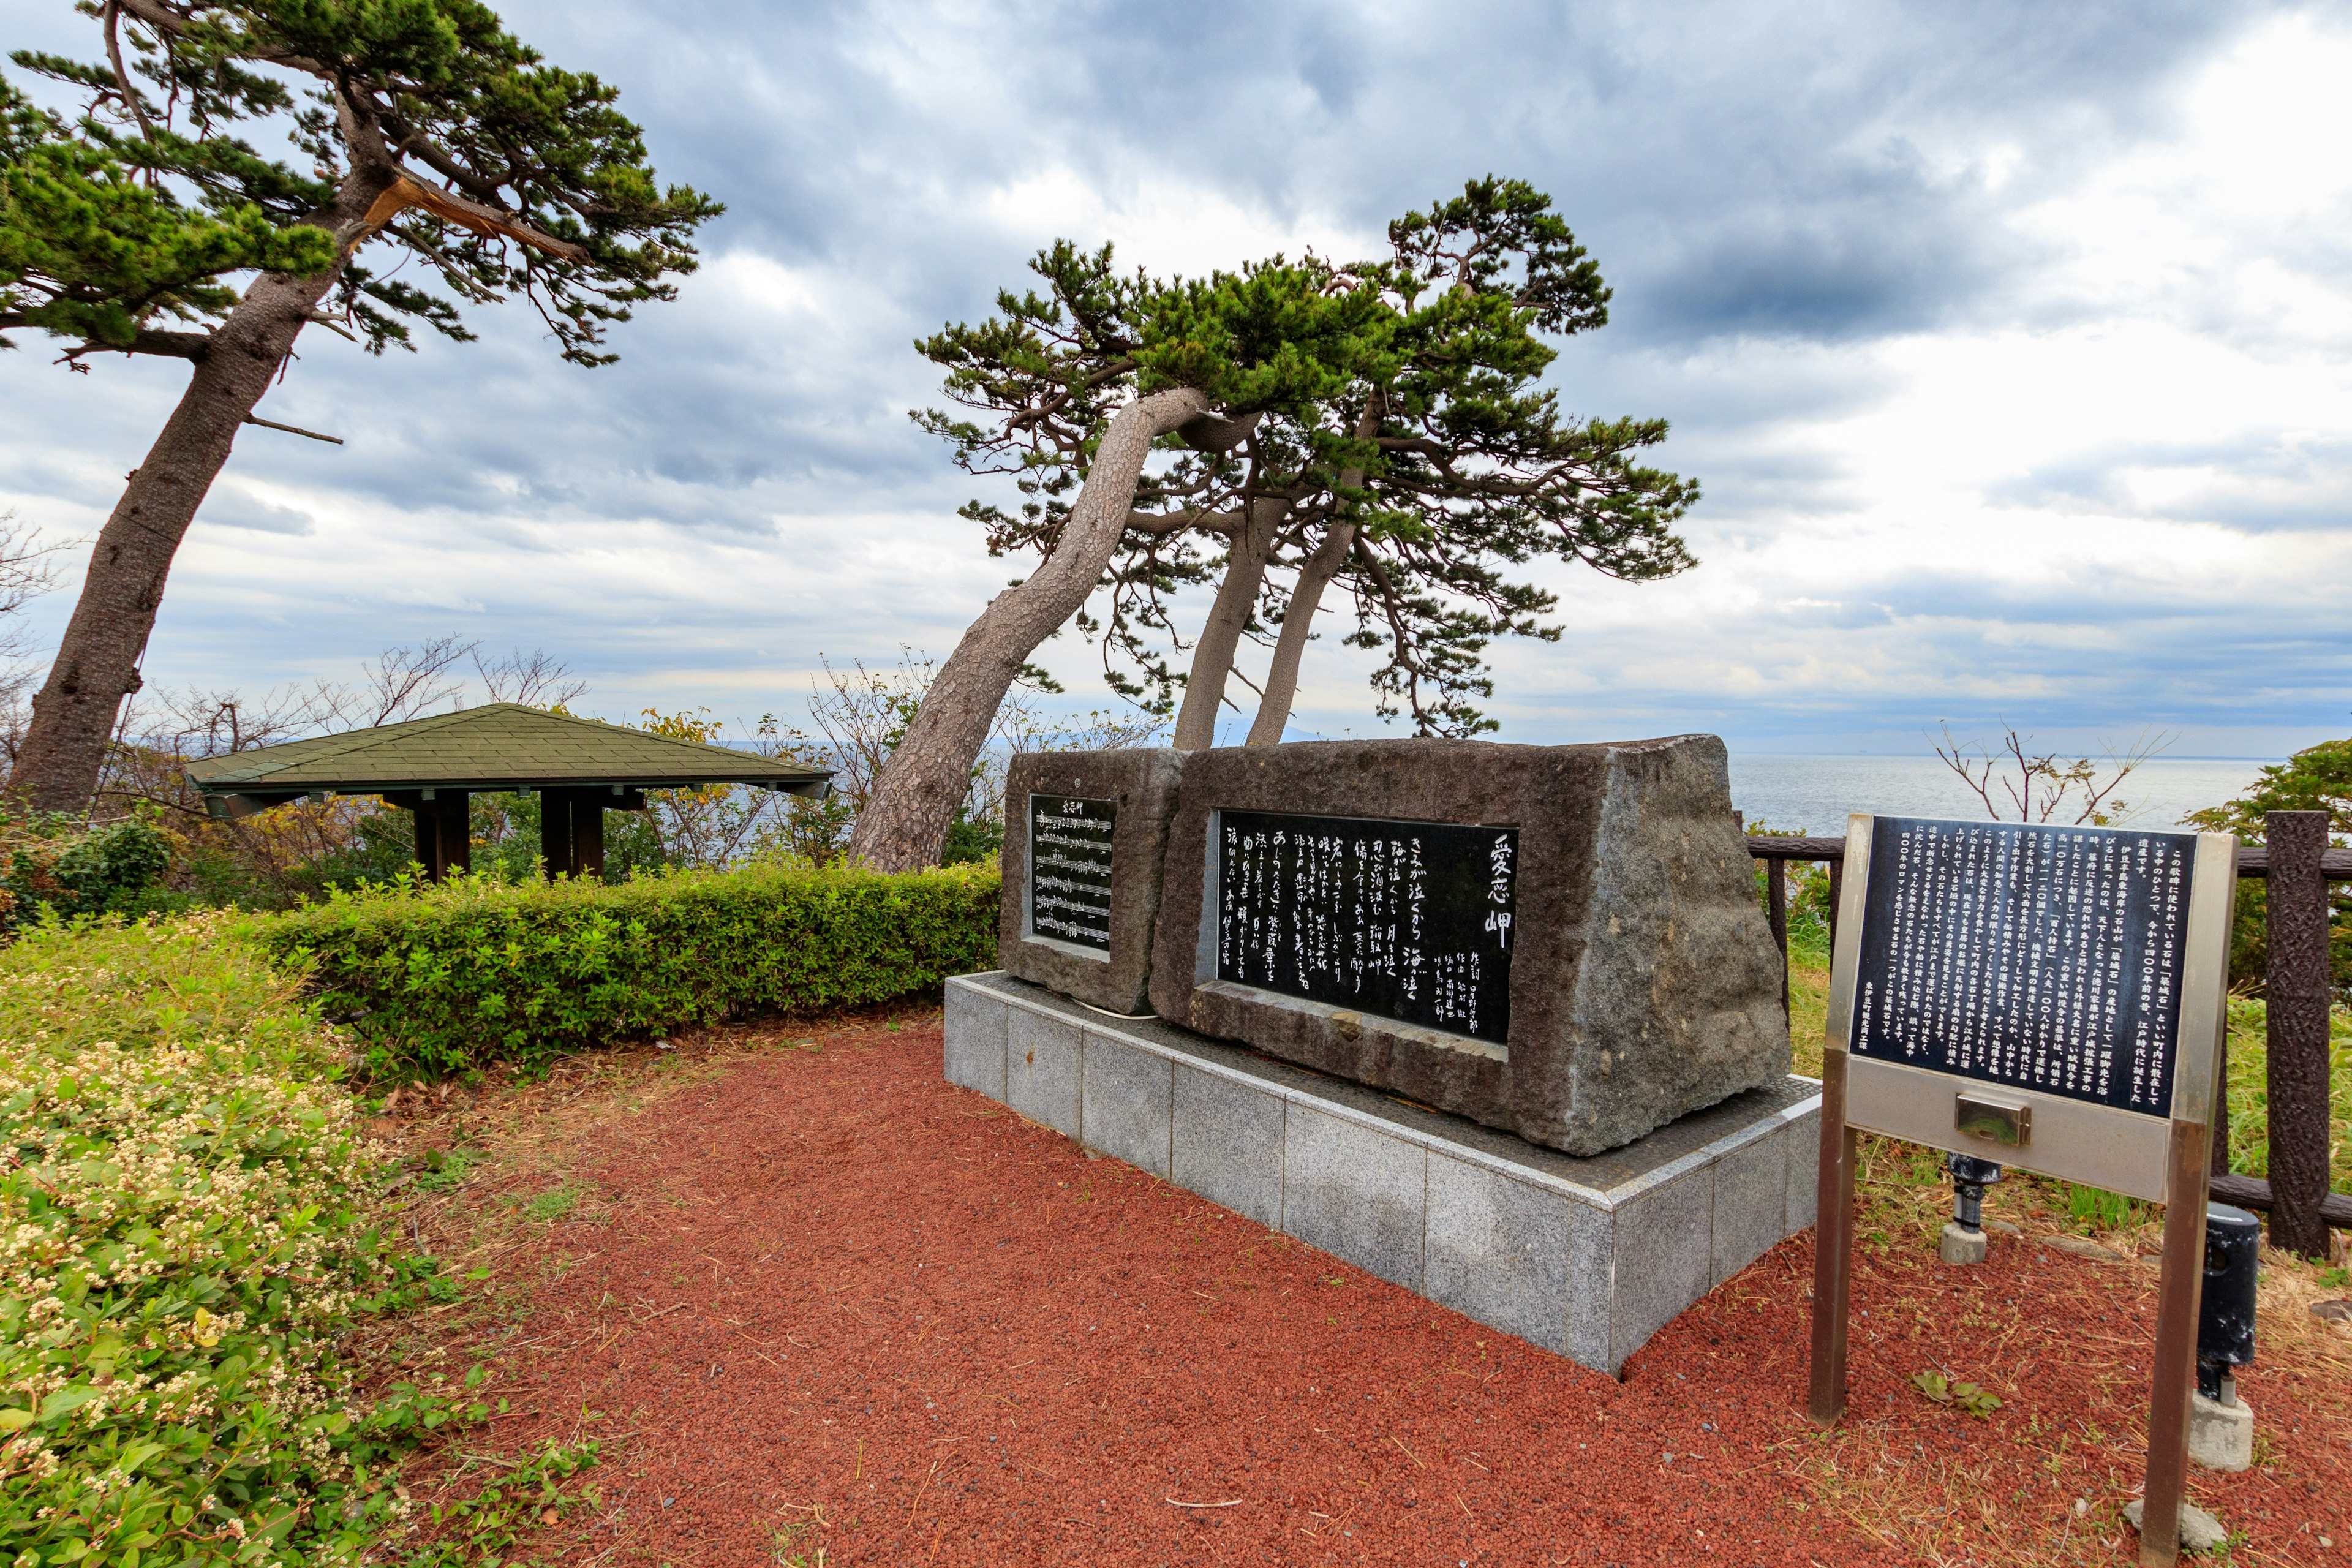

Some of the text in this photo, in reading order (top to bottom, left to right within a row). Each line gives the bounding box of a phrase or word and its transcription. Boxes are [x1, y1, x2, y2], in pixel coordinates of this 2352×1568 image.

[1485, 834, 1512, 948] 愛恋岬
[2136, 839, 2149, 878] 遺産です。
[1403, 838, 1427, 1000] きみが泣くから 海が泣く
[1858, 981, 1874, 1050] 東伊豆町観光商工課
